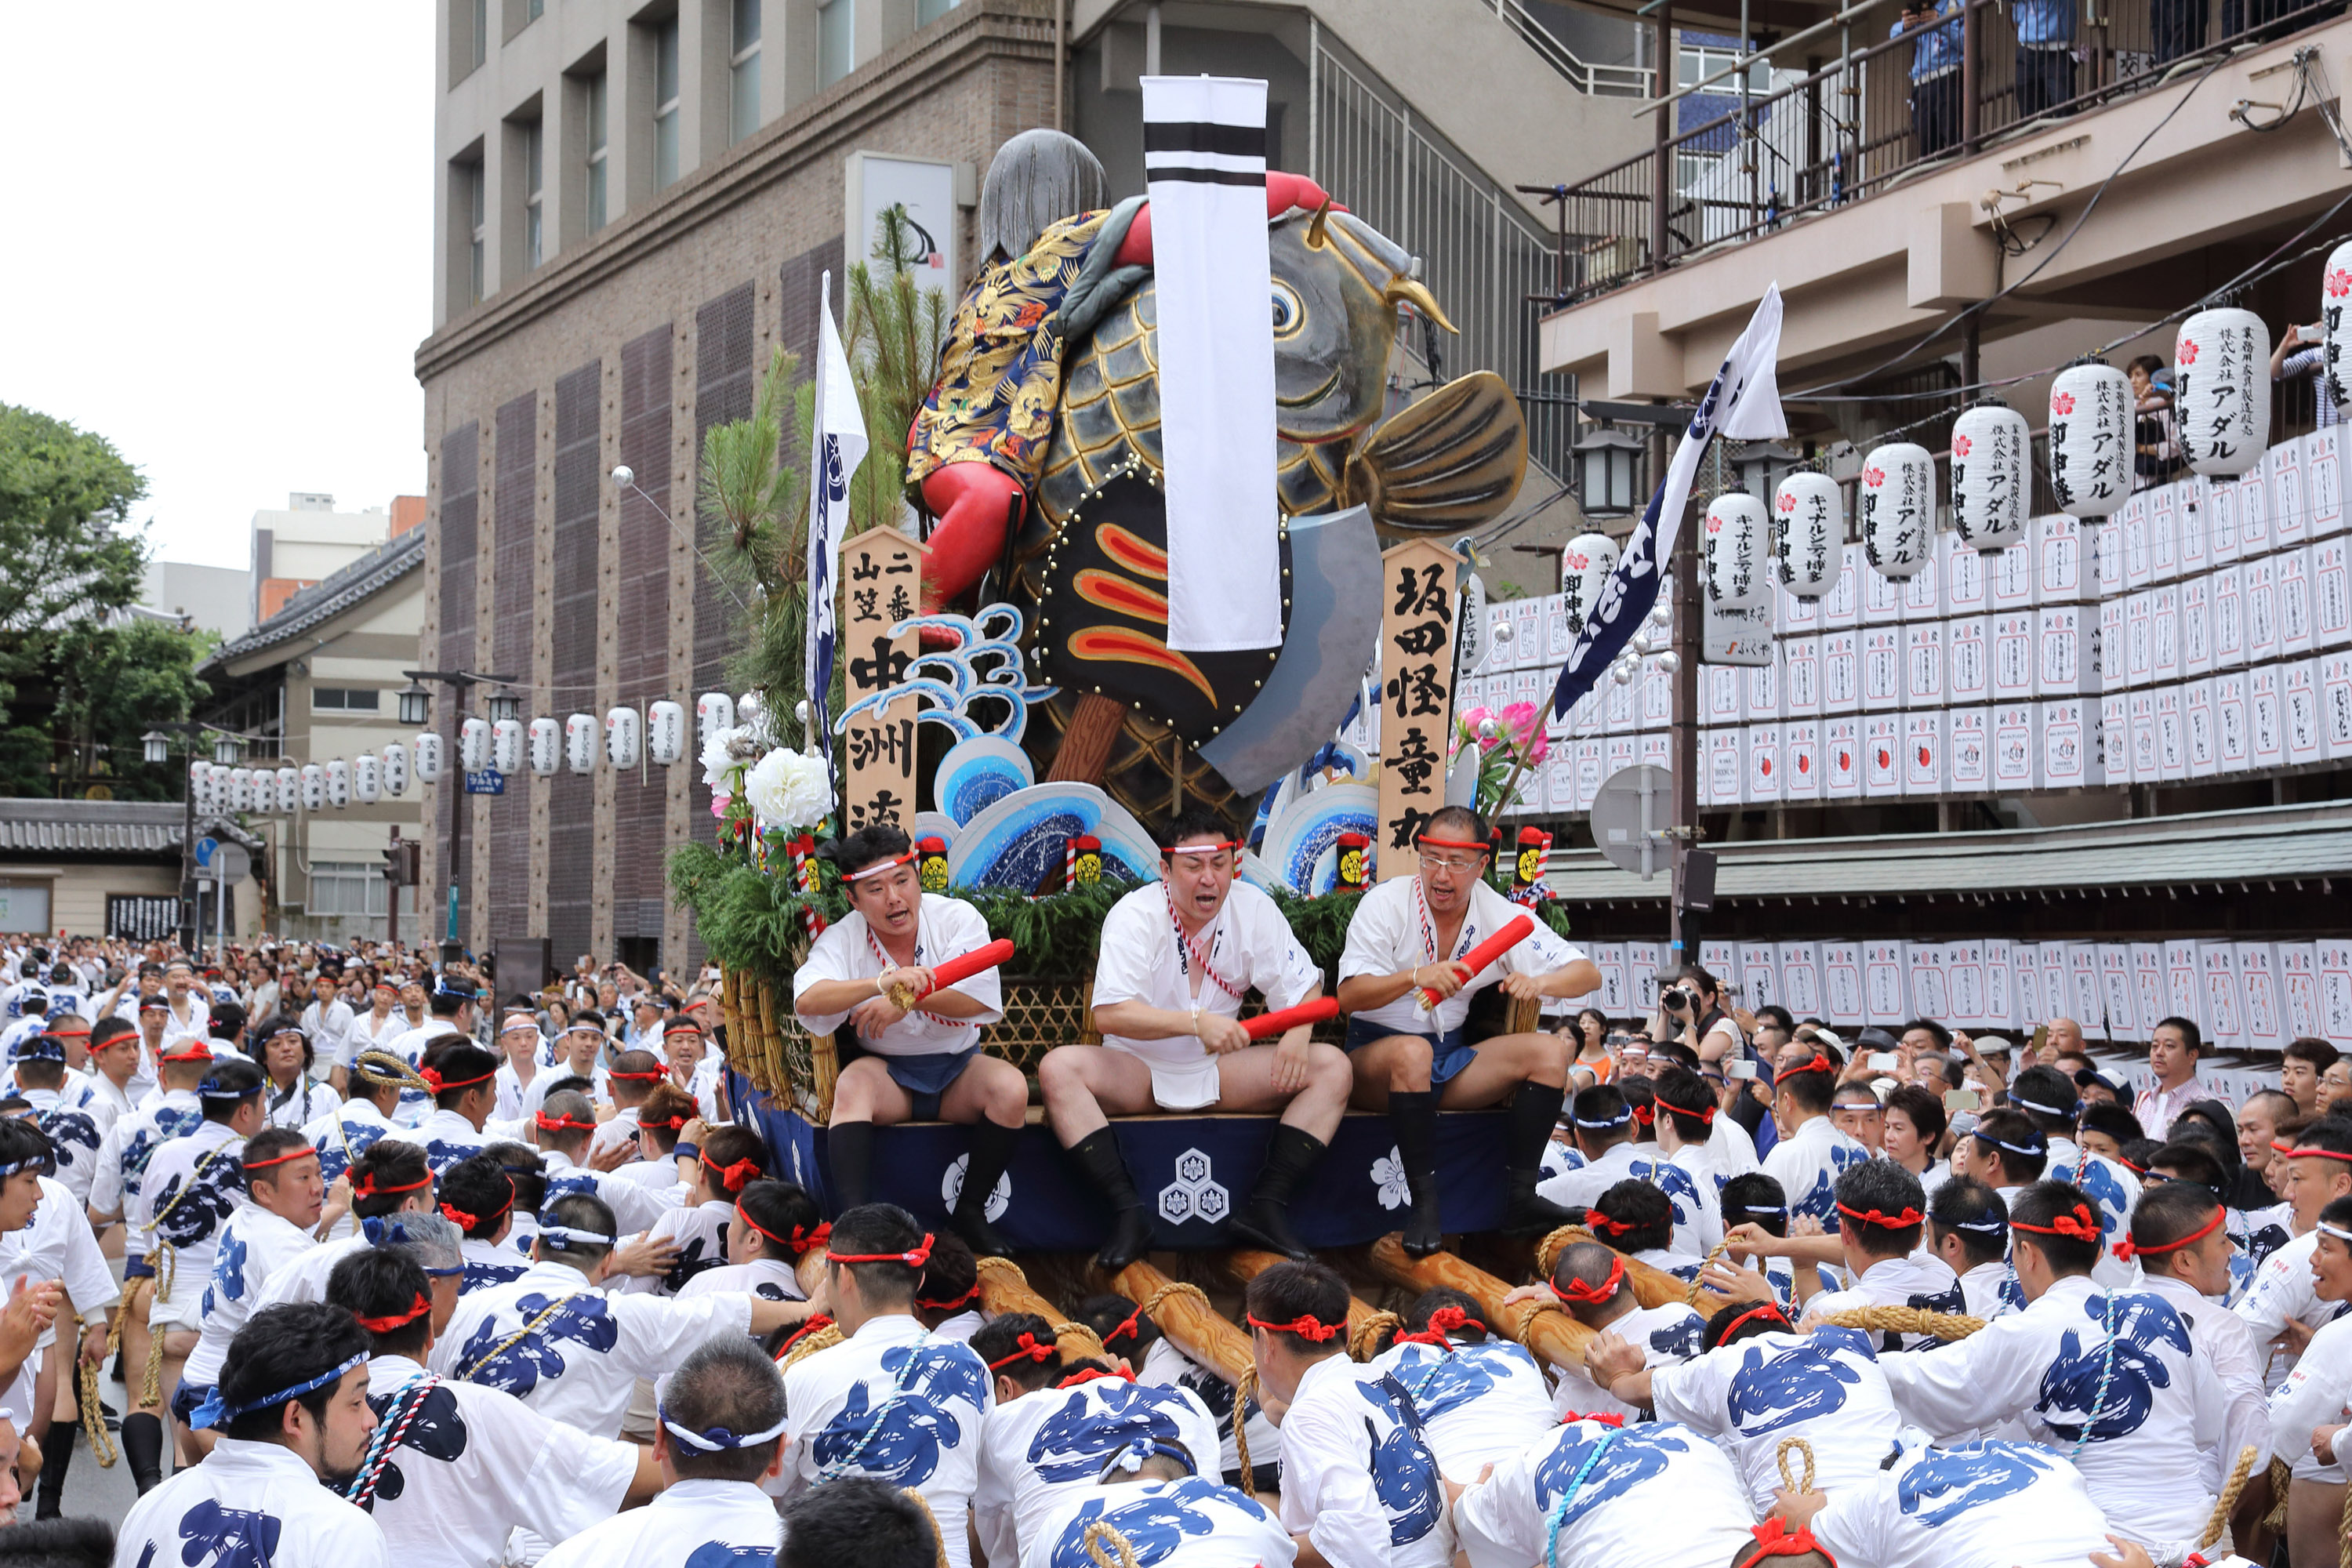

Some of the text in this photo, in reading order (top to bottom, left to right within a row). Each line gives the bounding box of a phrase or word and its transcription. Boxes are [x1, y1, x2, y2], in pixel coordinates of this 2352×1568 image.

[2207, 327, 2238, 459] 株式会社アダル
[1983, 424, 2009, 535] 株式会社アダル
[2089, 379, 2114, 500] 株式会社アダル
[1733, 514, 1753, 597] キャナルシティ博多
[1805, 494, 1827, 583] キャナルシティ博多
[1892, 461, 1916, 565] 株式会社アダル
[852, 552, 883, 622] 山笠
[884, 552, 914, 622] 二番
[1738, 643, 1770, 656] ふくや
